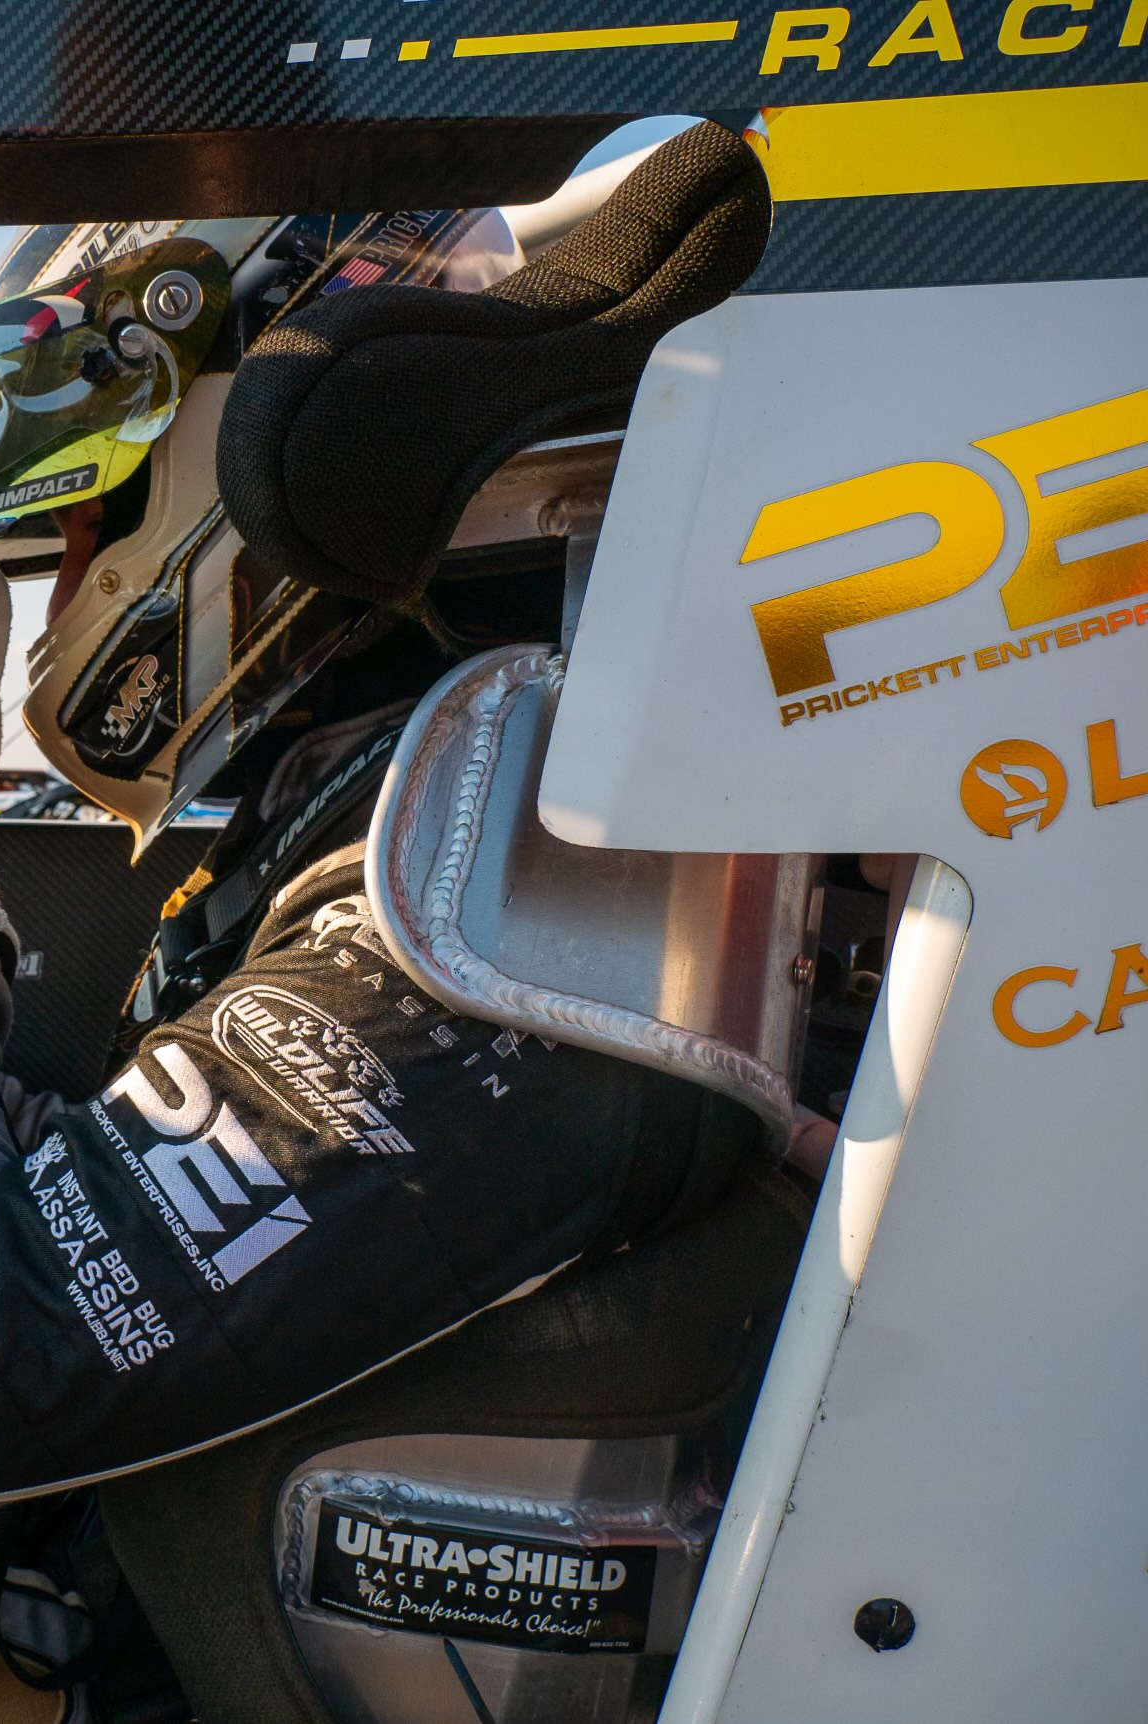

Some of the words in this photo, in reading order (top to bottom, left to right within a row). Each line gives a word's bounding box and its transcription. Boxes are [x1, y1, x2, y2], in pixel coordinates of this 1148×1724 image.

[139, 674, 170, 720] RACING
[780, 655, 965, 727] PRICKETT
[276, 727, 405, 860] IMPAC
[228, 996, 415, 1154] WILDLIFE
[269, 1058, 377, 1155] WARRIOR
[88, 1099, 129, 1150] PRICKETT
[33, 1186, 154, 1365] ASSASSINS
[101, 1248, 140, 1296] BED
[133, 1300, 175, 1349] BUG
[356, 1562, 424, 1589] RACE
[446, 1579, 598, 1611] PRODUCTS
[398, 1594, 520, 1629] Professionals
